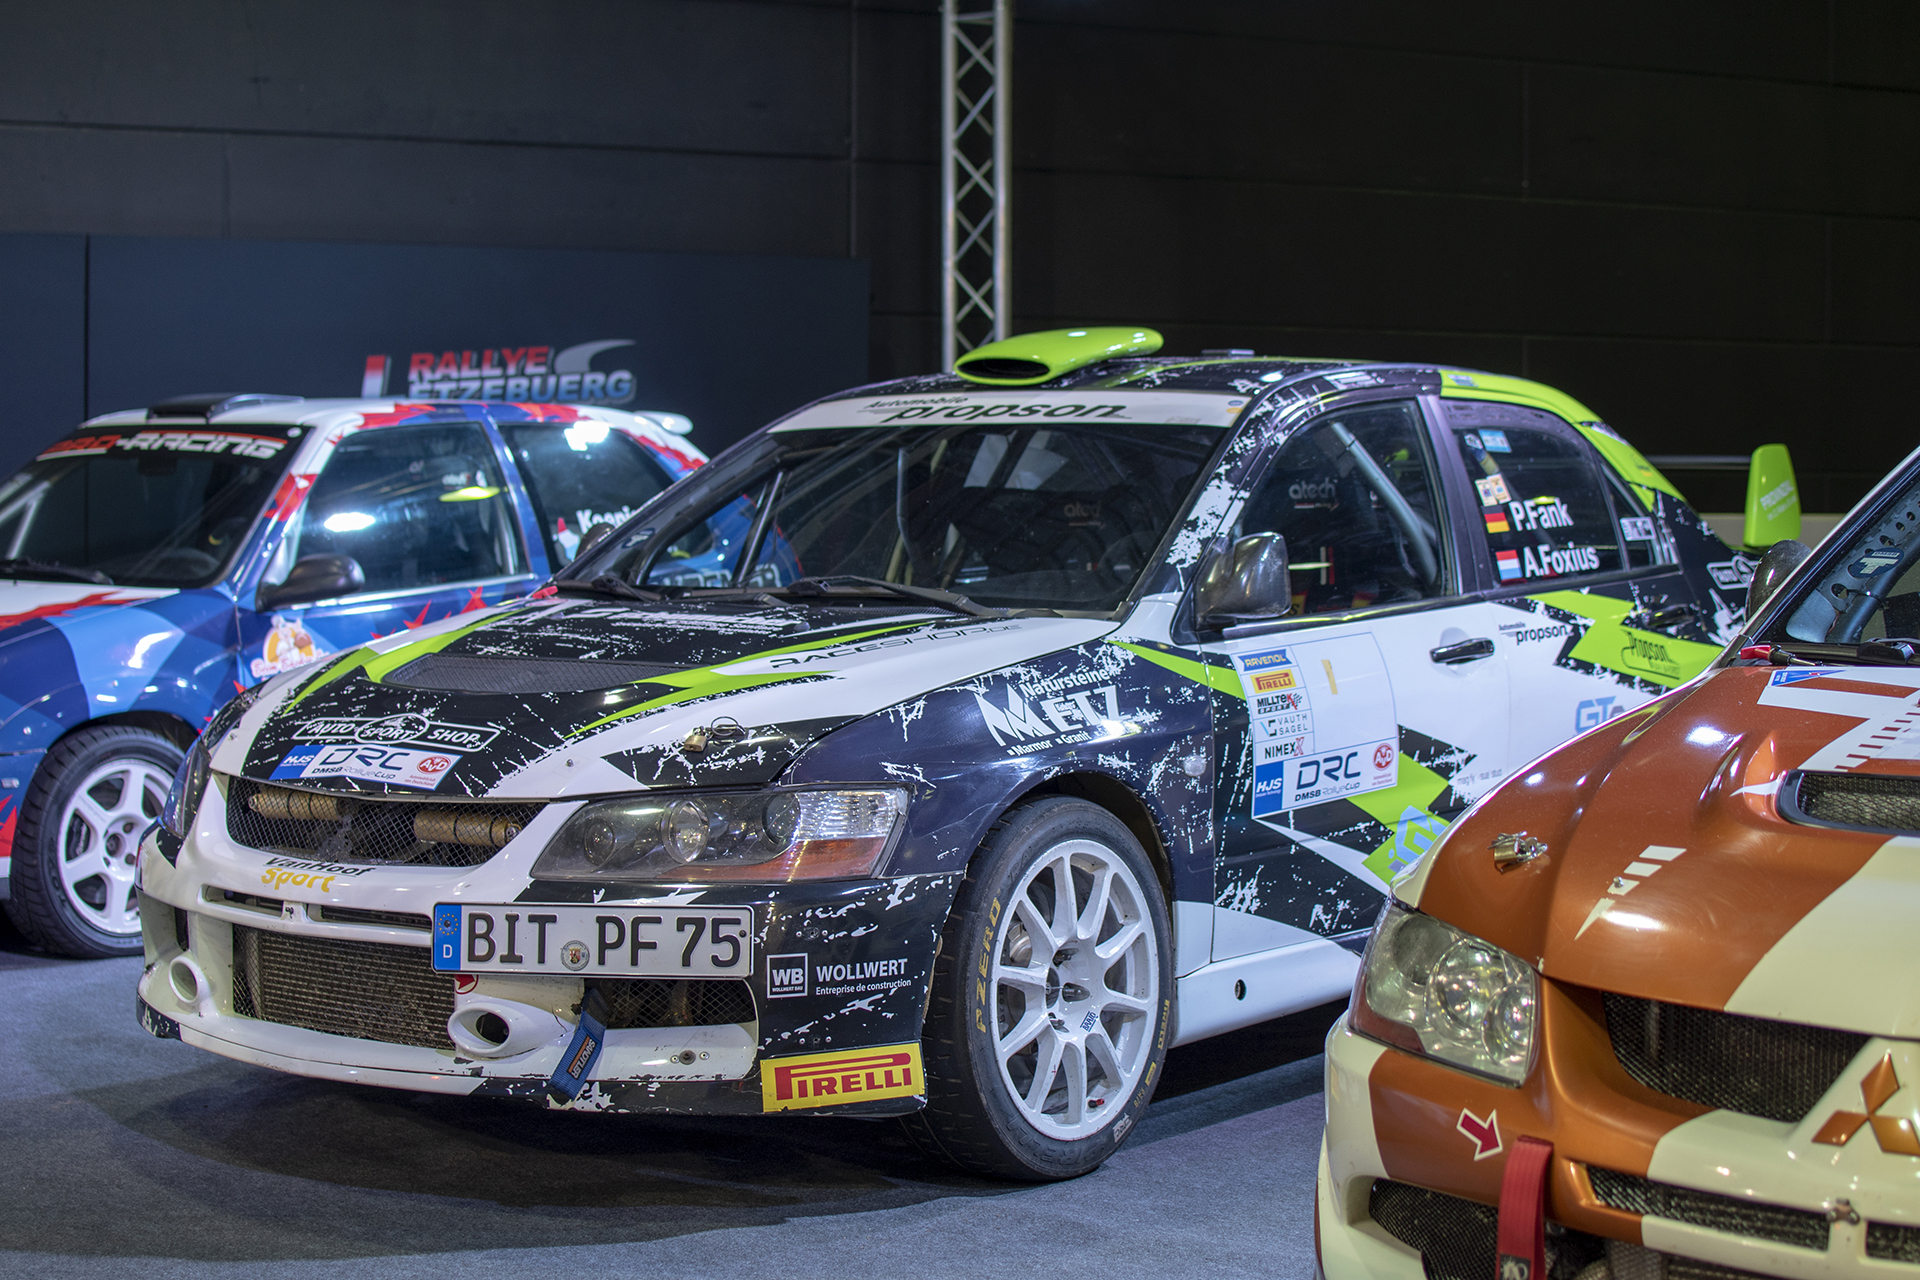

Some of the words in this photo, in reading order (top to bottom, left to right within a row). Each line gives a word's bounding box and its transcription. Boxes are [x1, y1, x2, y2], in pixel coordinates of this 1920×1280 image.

[408, 346, 550, 382] RALLYE
[879, 402, 1132, 424] propson
[576, 504, 638, 535] Koeni
[1508, 497, 1574, 532] P.Fank
[1522, 540, 1601, 578] A.Foxius
[1515, 624, 1568, 646] propson
[1244, 653, 1287, 667] RAVENOL
[1018, 667, 1111, 698] Natursteine
[1254, 672, 1293, 691] PIRELLI
[1277, 713, 1308, 725] VAUTH
[1278, 724, 1308, 736] SAGEL
[360, 726, 413, 740] SPORT
[428, 728, 481, 745] SHOP
[1014, 740, 1053, 756] Marmor
[1062, 731, 1092, 745] Granit
[283, 755, 315, 764] HJS
[318, 746, 411, 771] DRC
[311, 766, 344, 774] DMSB
[1296, 751, 1361, 790] DRC
[1256, 778, 1283, 793] HJS
[1294, 789, 1322, 802] DMSB
[261, 867, 337, 893] Sport
[467, 912, 558, 964] BIT
[596, 914, 663, 967] PF
[676, 916, 742, 968] 75
[442, 944, 453, 959] D
[771, 967, 804, 986] WB
[815, 957, 908, 983] WOLLWERT
[815, 985, 855, 997] Entreprise
[855, 983, 866, 993] de
[866, 978, 912, 992] construction
[570, 1038, 596, 1080] SANDTLER
[774, 1052, 912, 1101] PIRELLI
